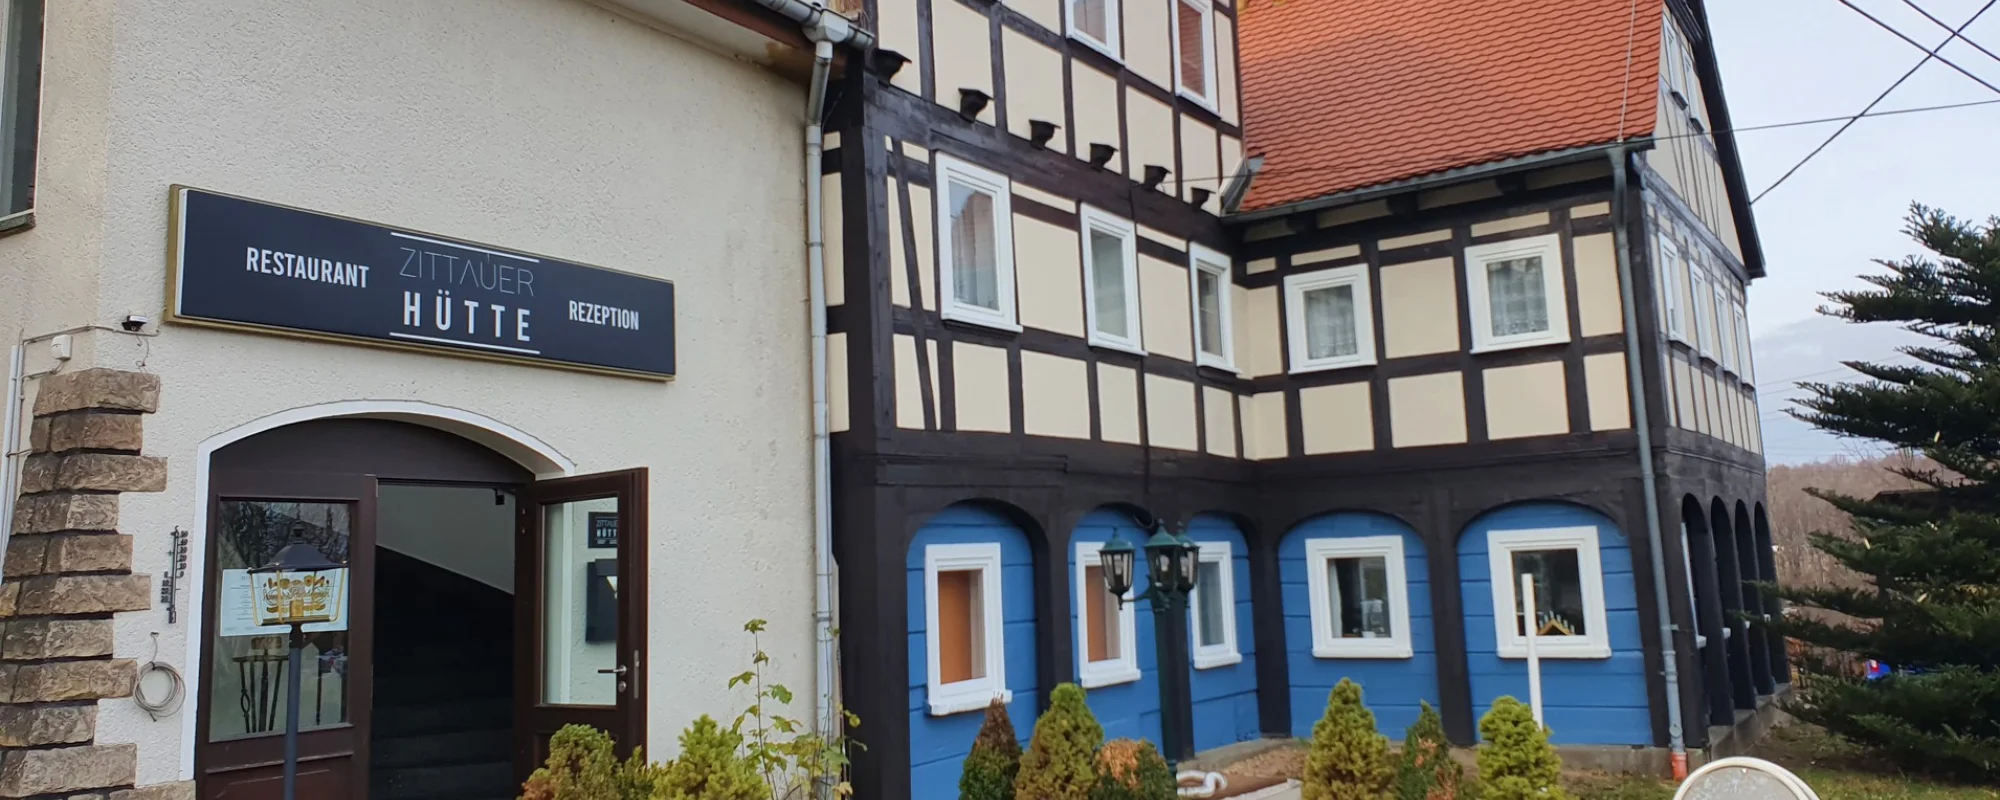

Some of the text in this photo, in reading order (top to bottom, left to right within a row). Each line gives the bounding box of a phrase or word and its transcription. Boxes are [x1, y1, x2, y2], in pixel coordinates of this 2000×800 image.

[246, 246, 370, 289] RESTAURANT
[399, 246, 535, 297] ZITTAUER
[403, 289, 531, 342] HÜTTE
[569, 299, 640, 331] REZEPTION
[596, 527, 617, 538] HÜTT
